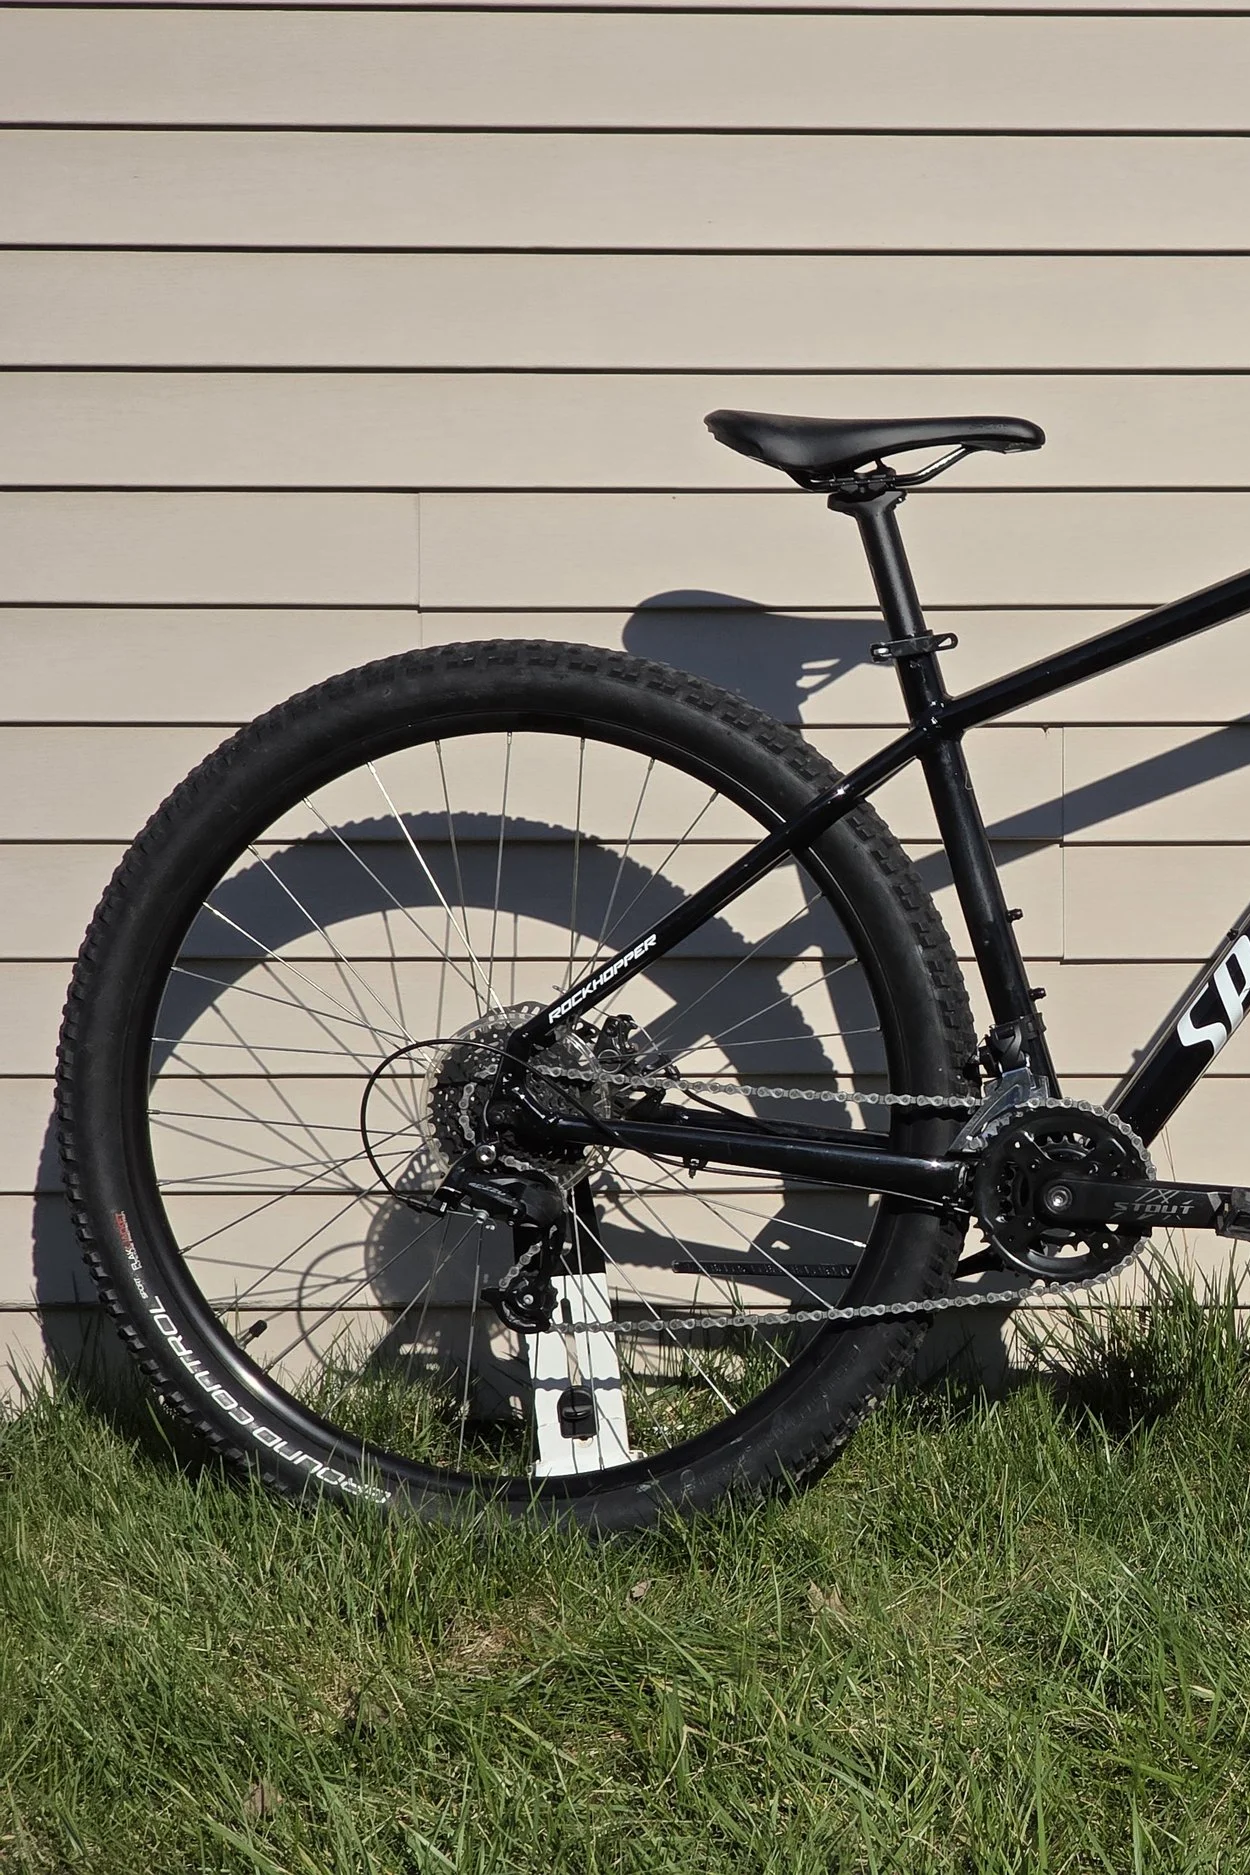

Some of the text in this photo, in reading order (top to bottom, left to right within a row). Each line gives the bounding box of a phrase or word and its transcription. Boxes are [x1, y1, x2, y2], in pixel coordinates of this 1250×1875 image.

[548, 933, 657, 1025] ROCKHOPPER
[1113, 1202, 1195, 1214] STOUT
[133, 1276, 149, 1299] SPORT
[147, 1294, 255, 1426] CONTROL
